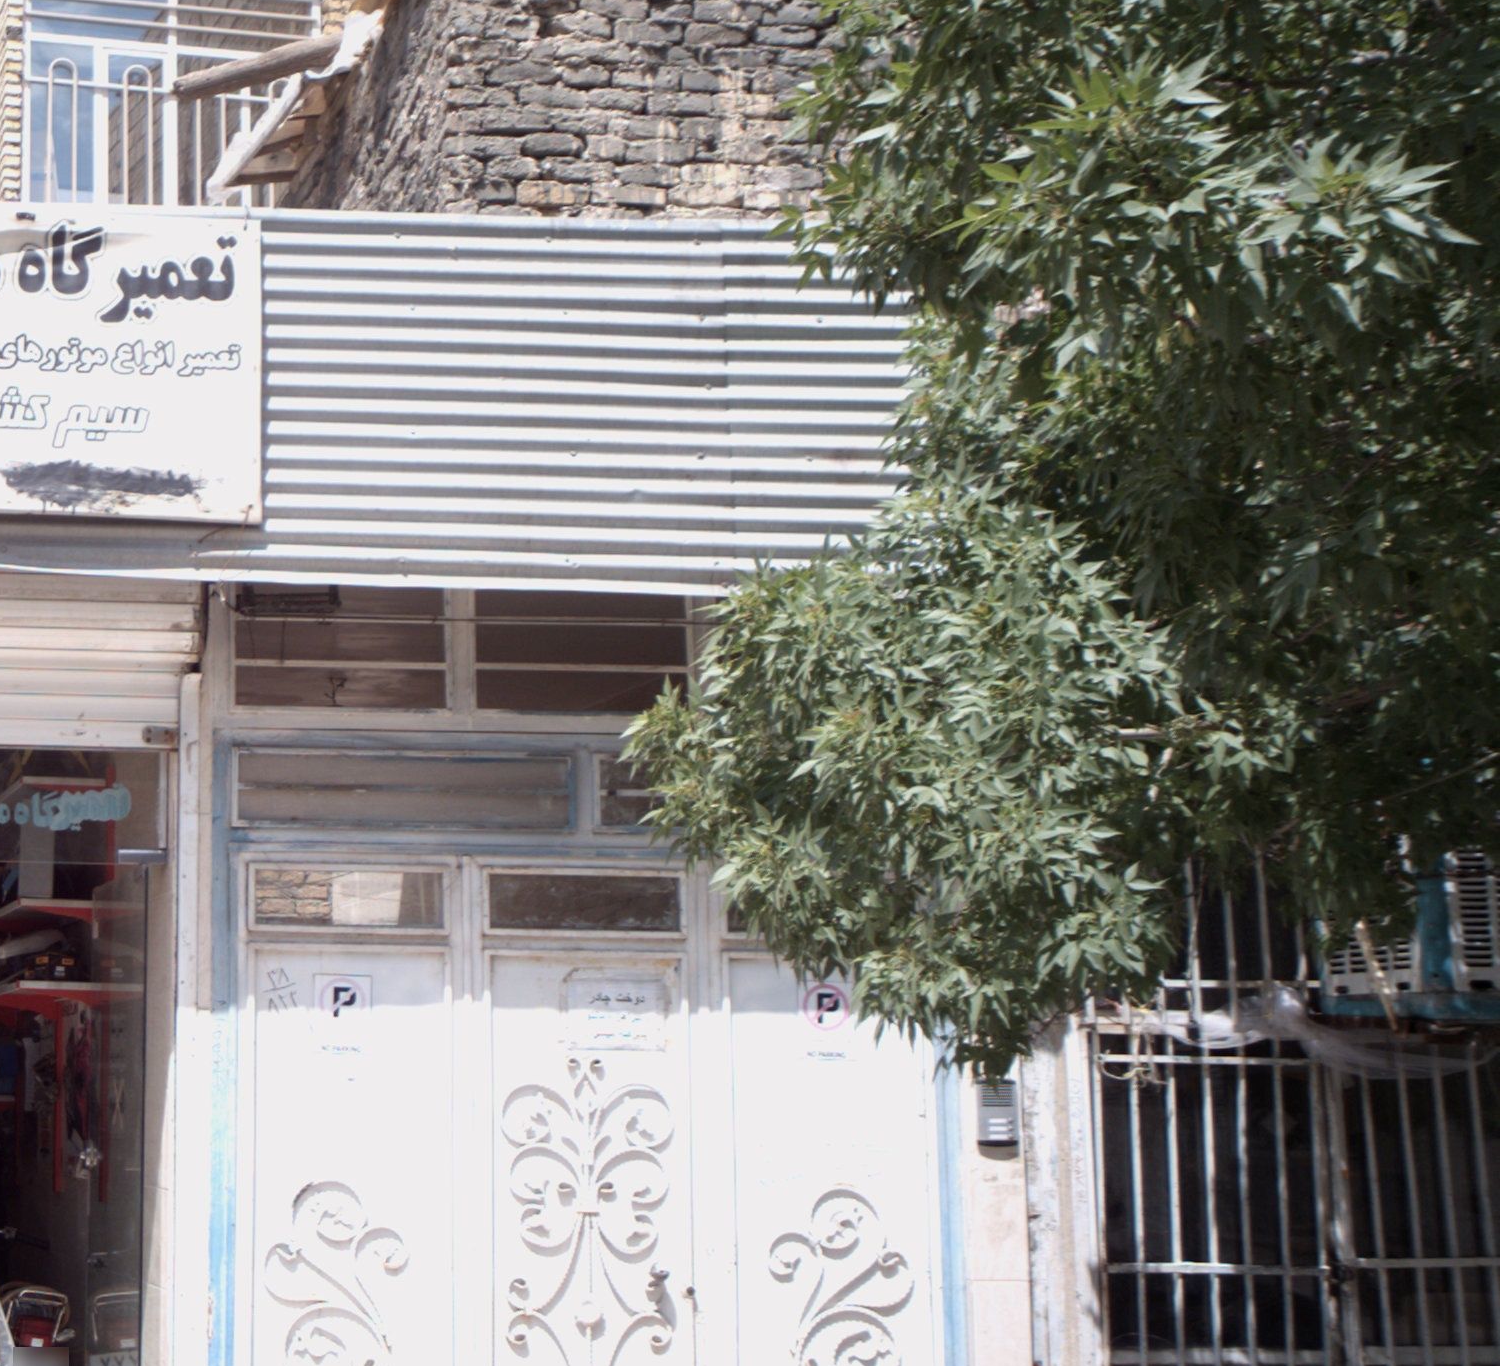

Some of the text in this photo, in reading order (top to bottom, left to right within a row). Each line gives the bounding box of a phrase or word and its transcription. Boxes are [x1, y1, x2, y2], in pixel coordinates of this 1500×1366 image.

[110, 339, 175, 376] انواع
[176, 343, 242, 377] تعمیر
[51, 404, 150, 449] سیم
